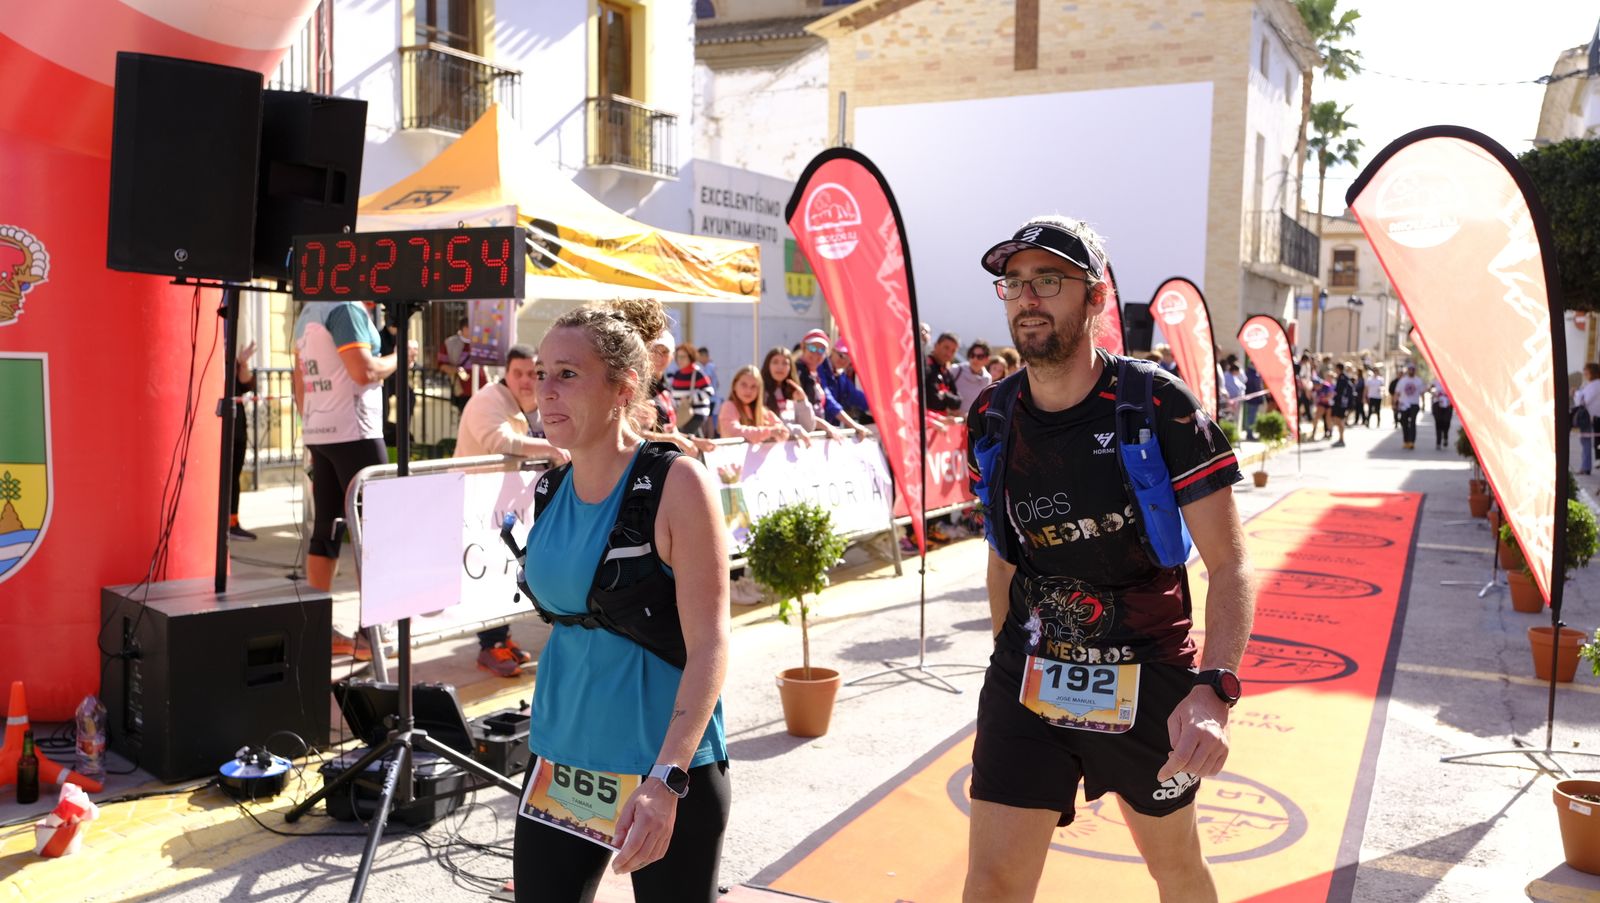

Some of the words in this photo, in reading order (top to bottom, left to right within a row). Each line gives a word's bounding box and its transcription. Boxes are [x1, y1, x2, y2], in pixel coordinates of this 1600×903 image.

[700, 186, 781, 217] EXCELENTÍSIMO
[702, 216, 778, 242] AYUNTAMIENTO
[300, 235, 510, 294] 02:27:54
[1015, 492, 1071, 528] pies
[1025, 503, 1136, 549] NEGROS
[1046, 640, 1136, 664] NEGROS
[1045, 663, 1116, 696] 192
[1072, 697, 1096, 705] MANUEL
[553, 762, 618, 804] 665
[571, 797, 593, 809] TAMARA
